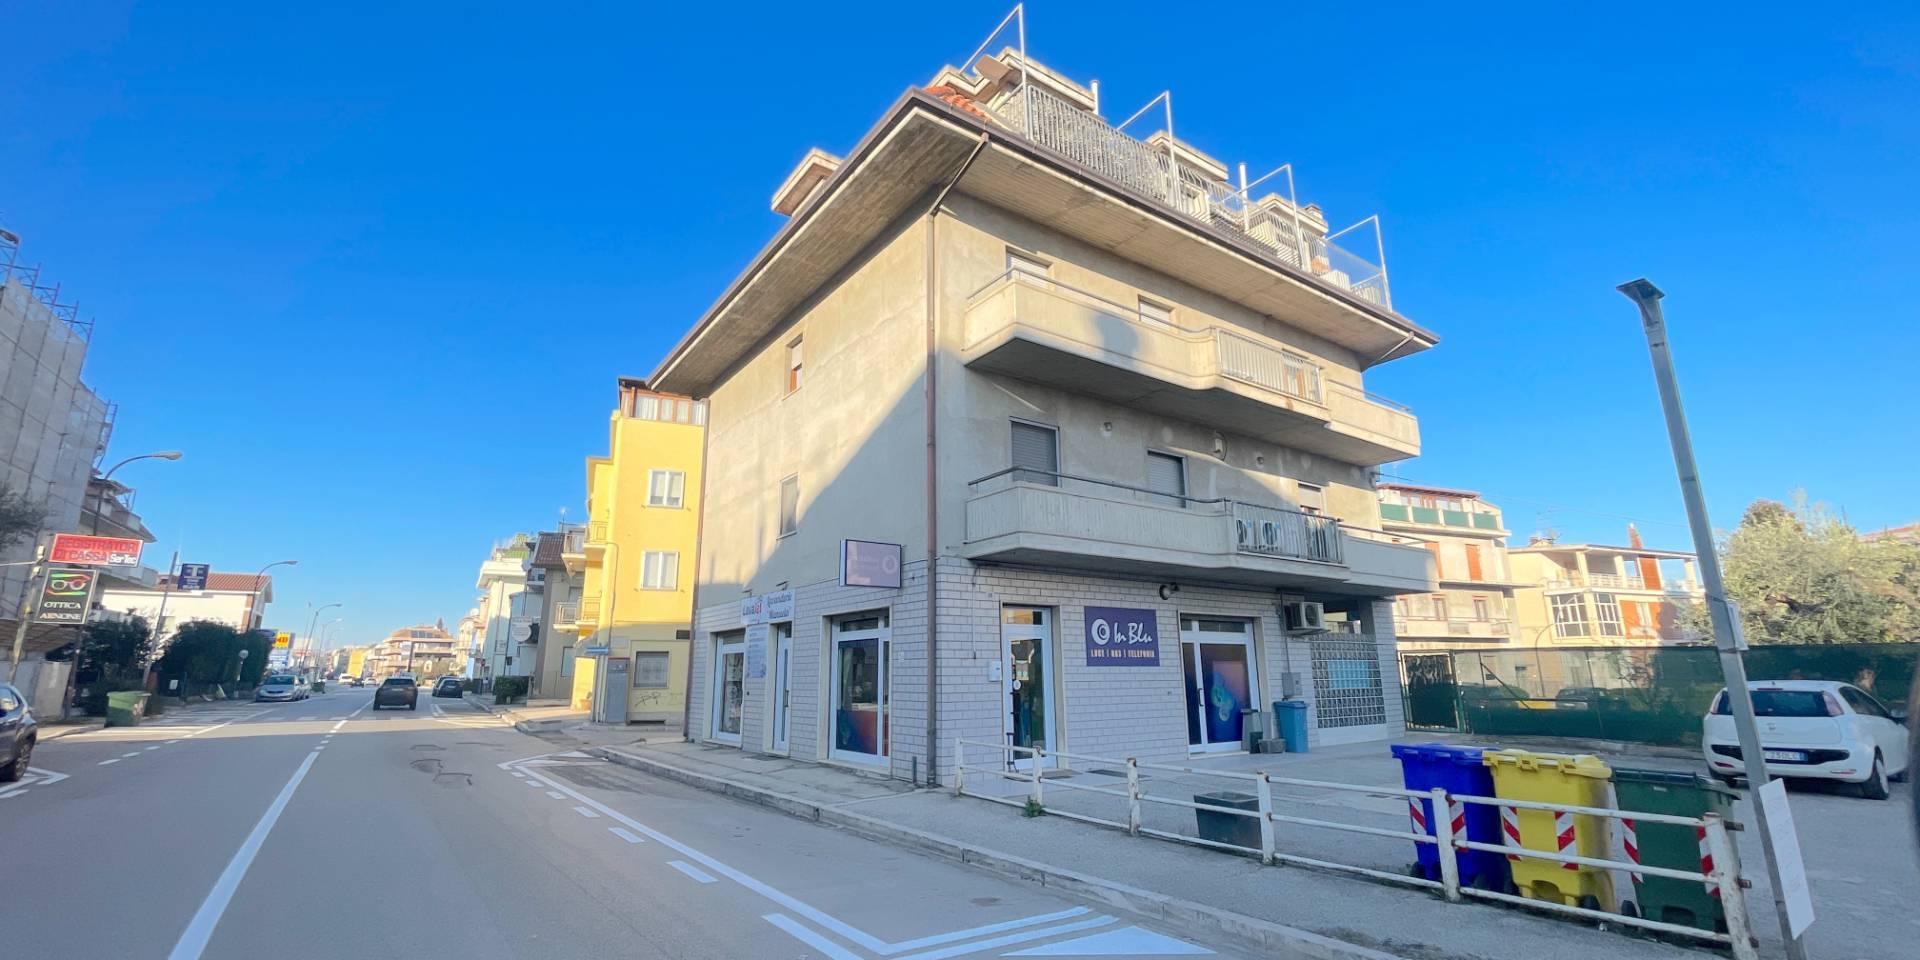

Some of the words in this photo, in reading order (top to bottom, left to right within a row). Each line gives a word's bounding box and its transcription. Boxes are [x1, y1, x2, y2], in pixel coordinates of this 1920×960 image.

[57, 539, 137, 553] REGISTRATORI
[70, 551, 108, 561] CASSA
[44, 601, 81, 609] OTTICA
[40, 612, 81, 620] ARNONE
[1114, 622, 1127, 643] In
[1128, 622, 1153, 644] Blu
